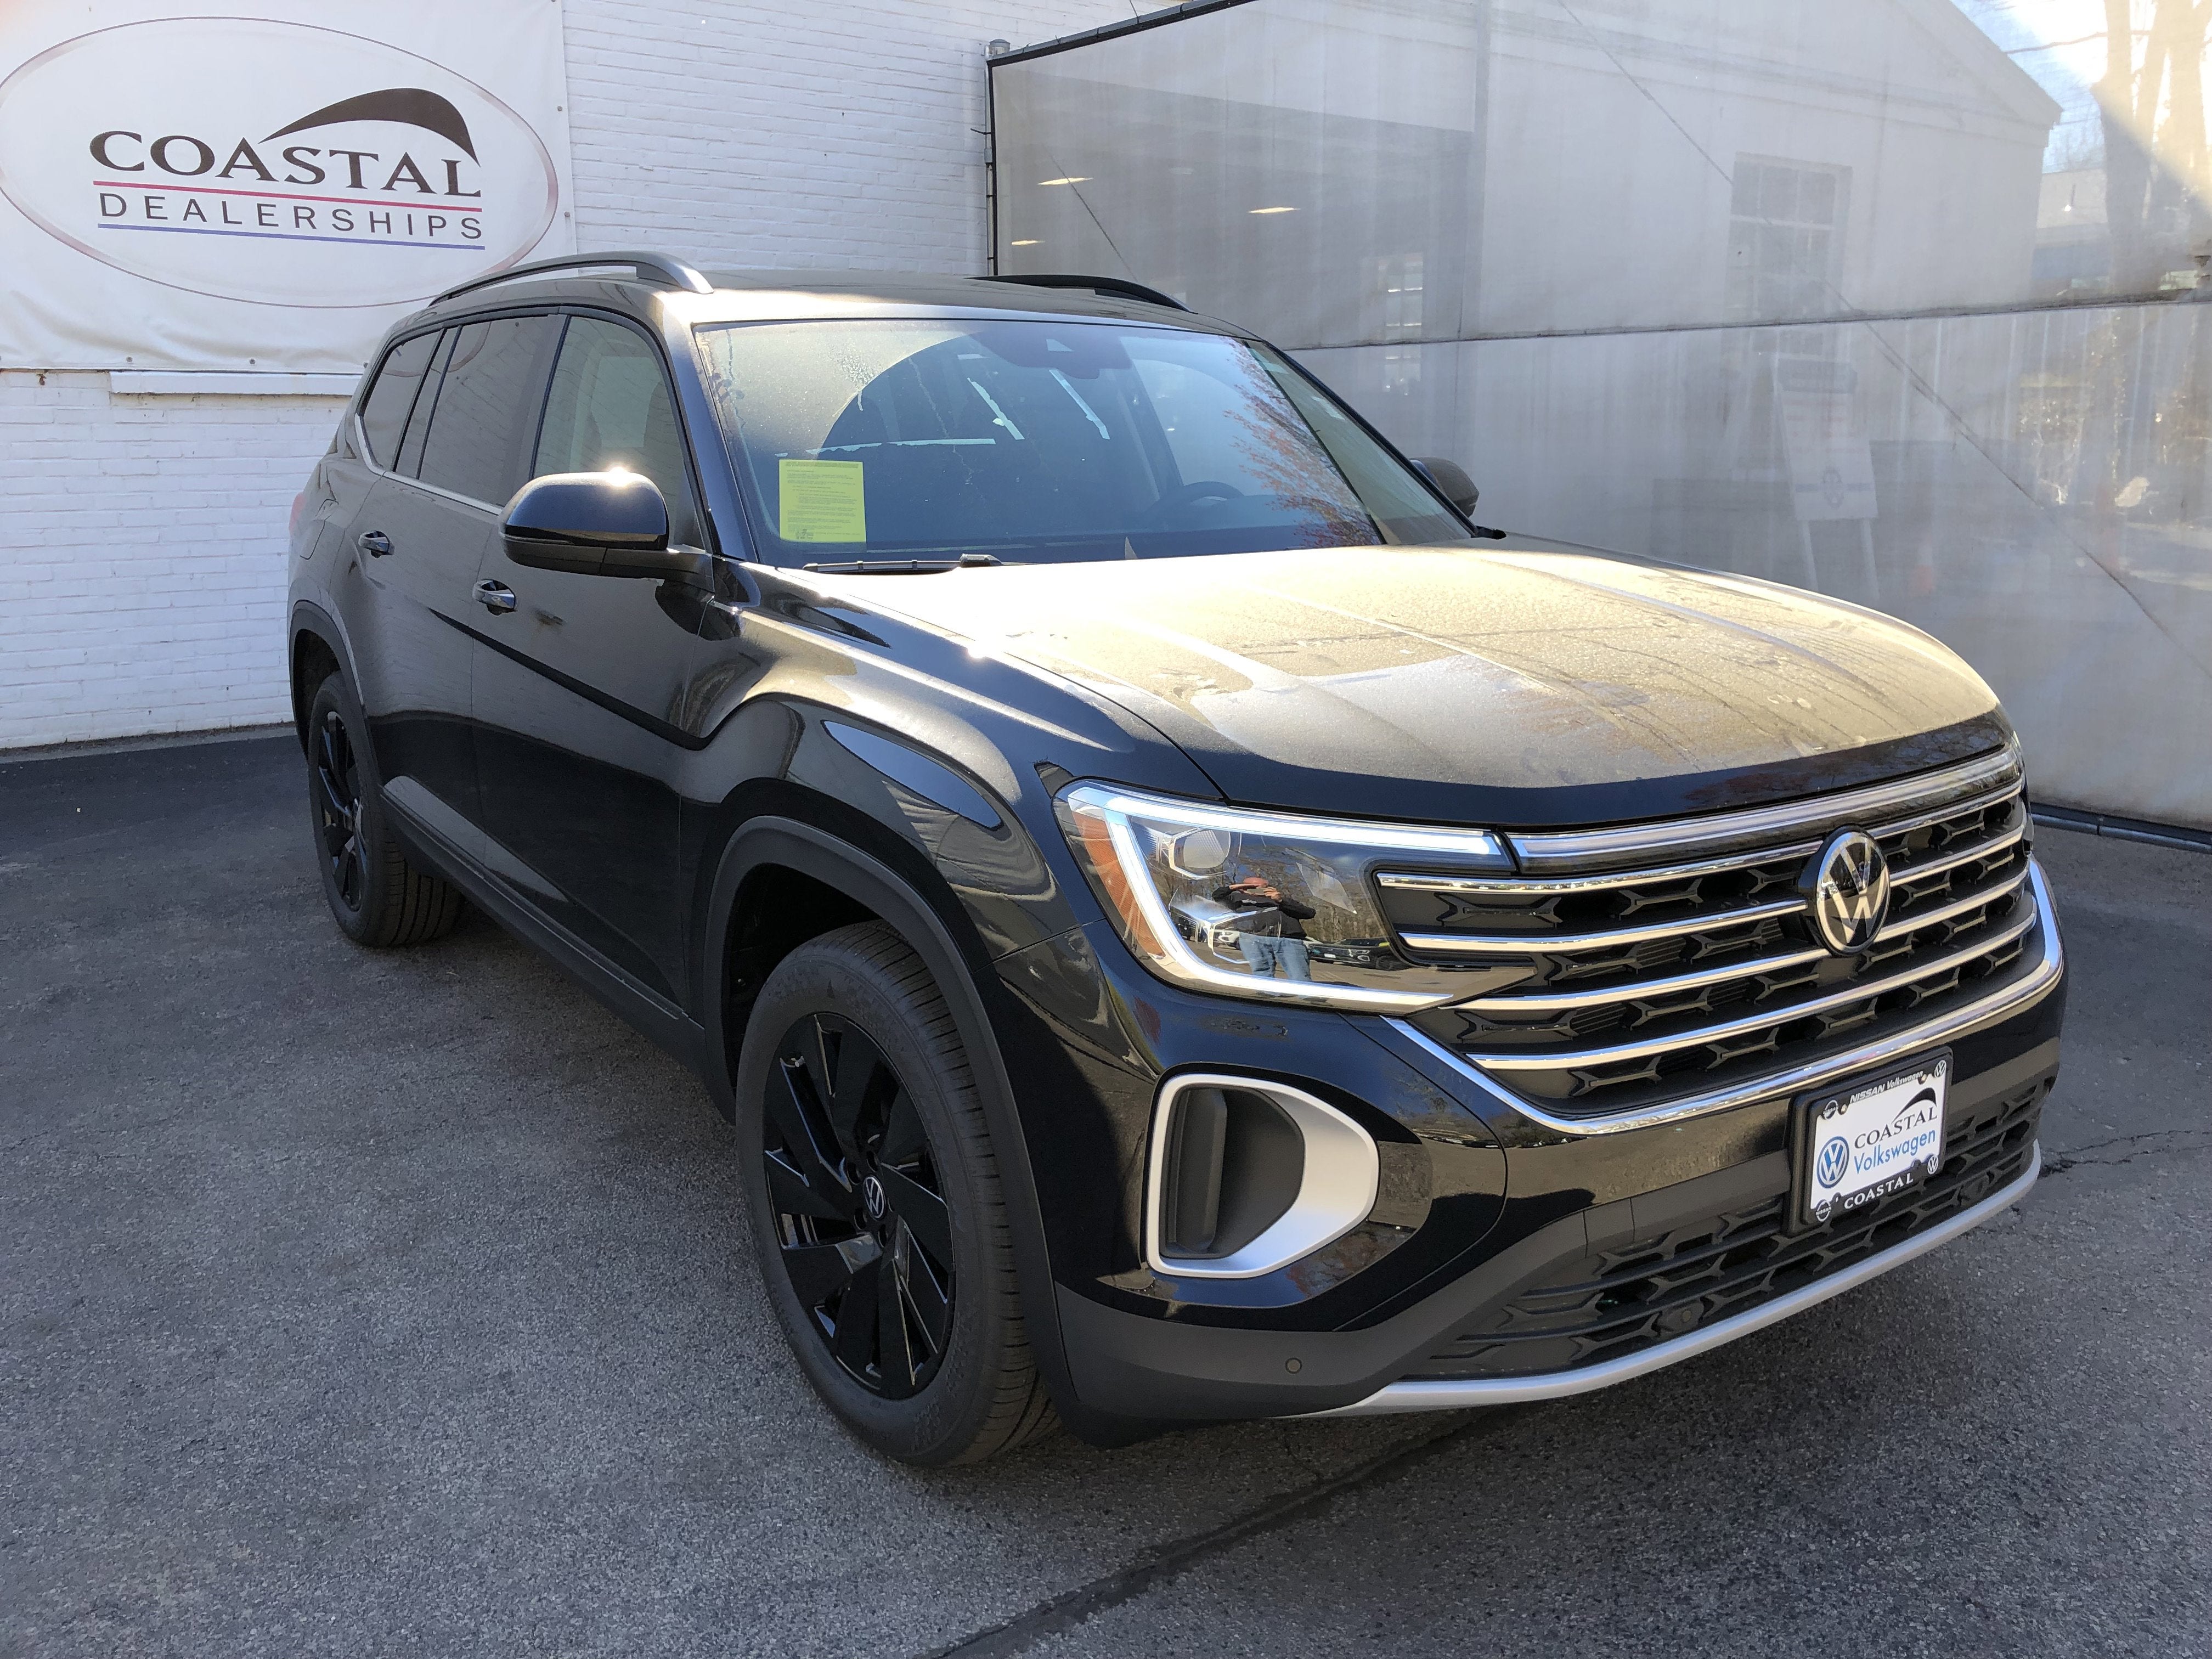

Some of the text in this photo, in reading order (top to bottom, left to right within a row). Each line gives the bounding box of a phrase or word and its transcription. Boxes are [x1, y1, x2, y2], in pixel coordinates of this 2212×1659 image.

[89, 131, 481, 198] COASTAL
[99, 192, 483, 240] DEALERSHIPS
[1850, 1070, 1923, 1103] NISSAN Volkswagen
[1854, 1107, 1937, 1149] COASTAL
[1854, 1130, 1936, 1175] Volkswagen
[1844, 1172, 1914, 1209] COASTAL
